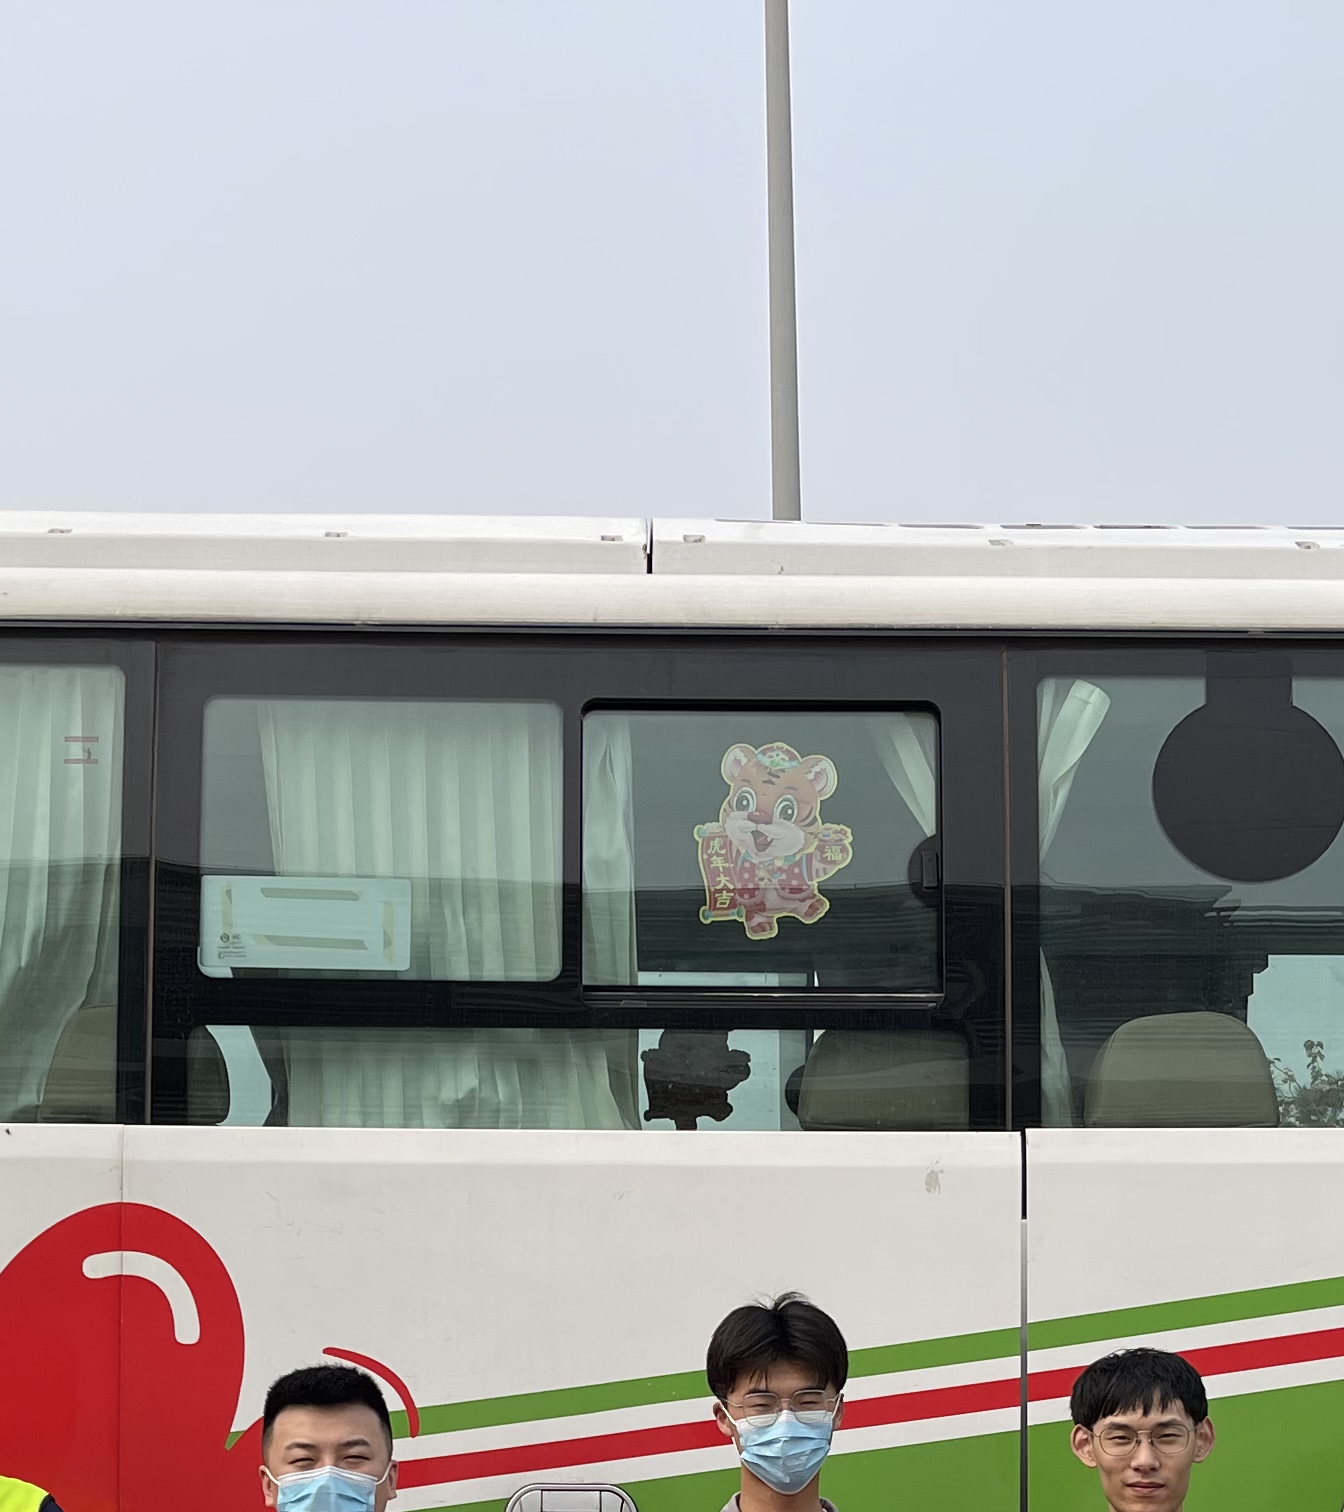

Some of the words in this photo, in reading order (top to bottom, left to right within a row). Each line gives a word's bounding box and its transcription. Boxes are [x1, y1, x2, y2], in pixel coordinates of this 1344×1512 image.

[707, 836, 735, 909] 虎年大吉
[823, 845, 843, 862] 福
